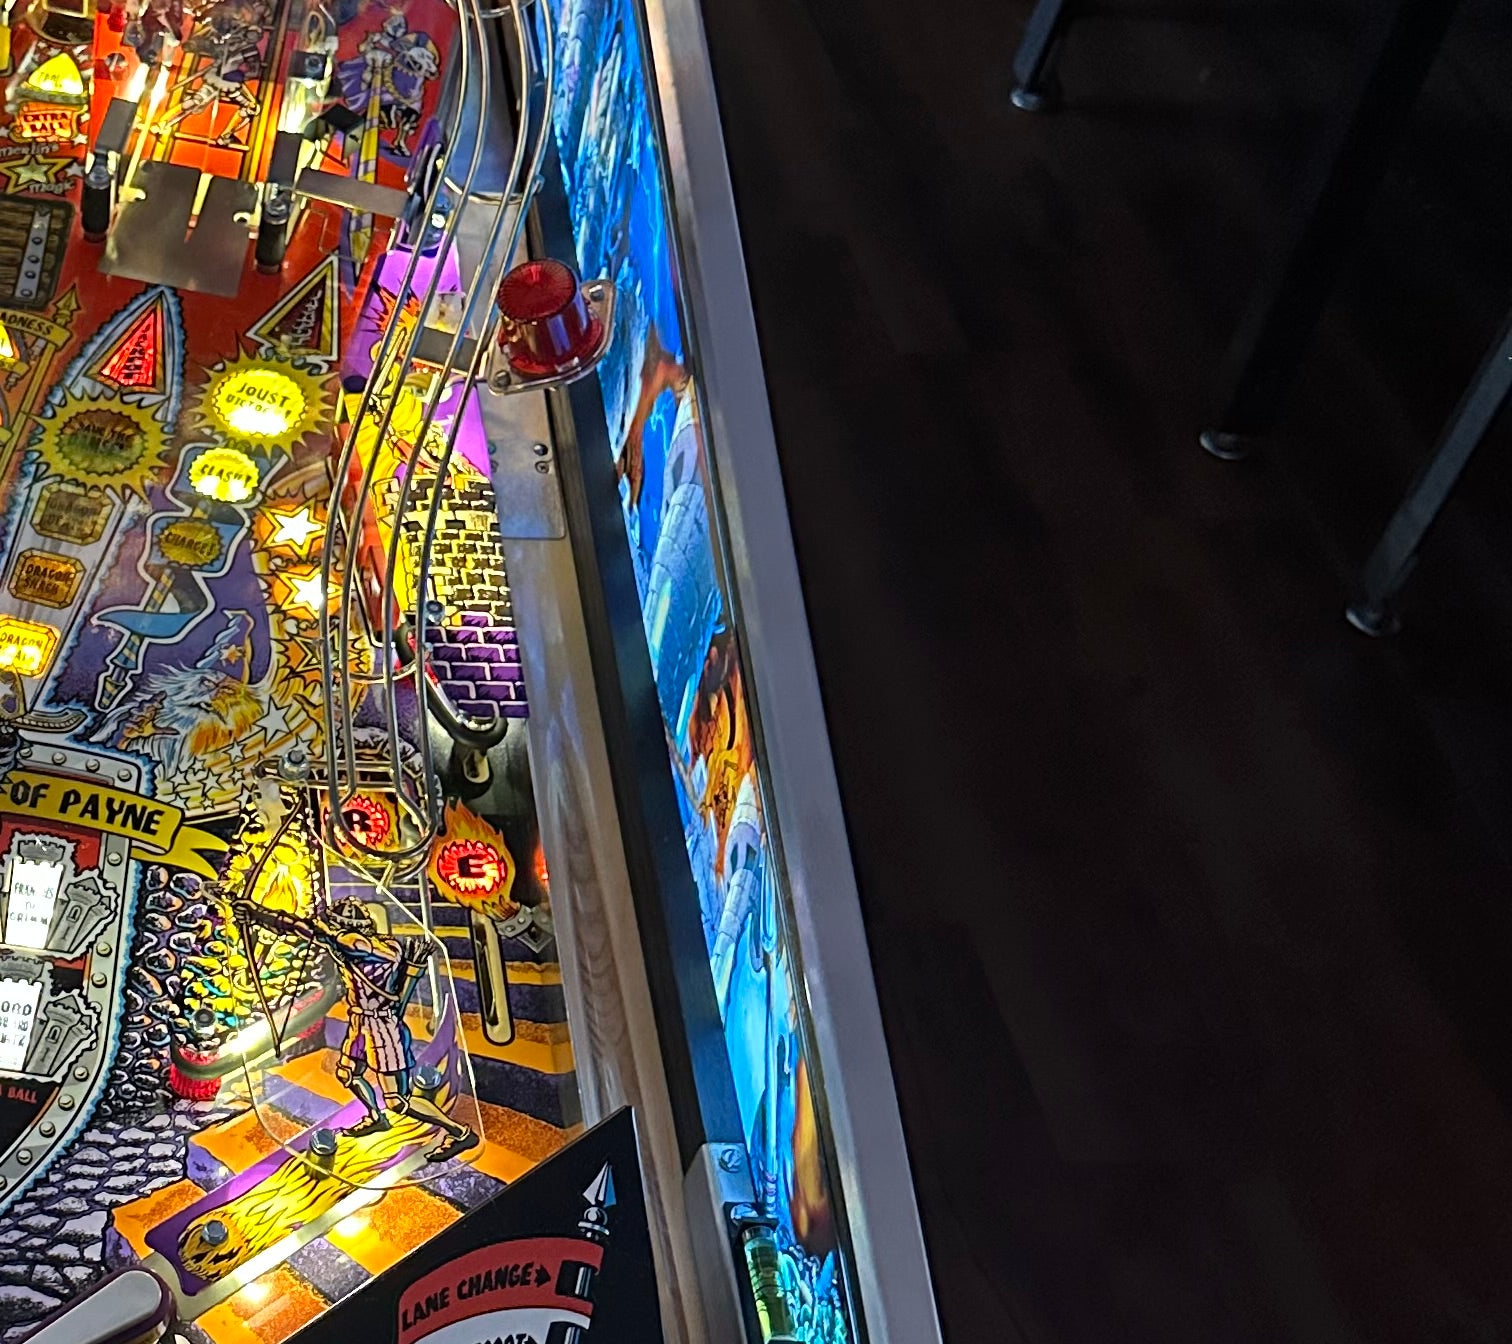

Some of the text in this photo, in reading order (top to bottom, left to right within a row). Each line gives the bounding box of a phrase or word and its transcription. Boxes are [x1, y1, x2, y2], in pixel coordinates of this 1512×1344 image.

[23, 113, 69, 122] EXTRA
[30, 122, 64, 132] BALL
[237, 381, 291, 408] JOUST
[25, 563, 73, 583] DRAGON
[10, 783, 165, 837] OF PAYNE
[458, 854, 488, 878] E
[8, 1086, 38, 1105] BALL
[401, 1263, 535, 1332] LANE CHANGE
